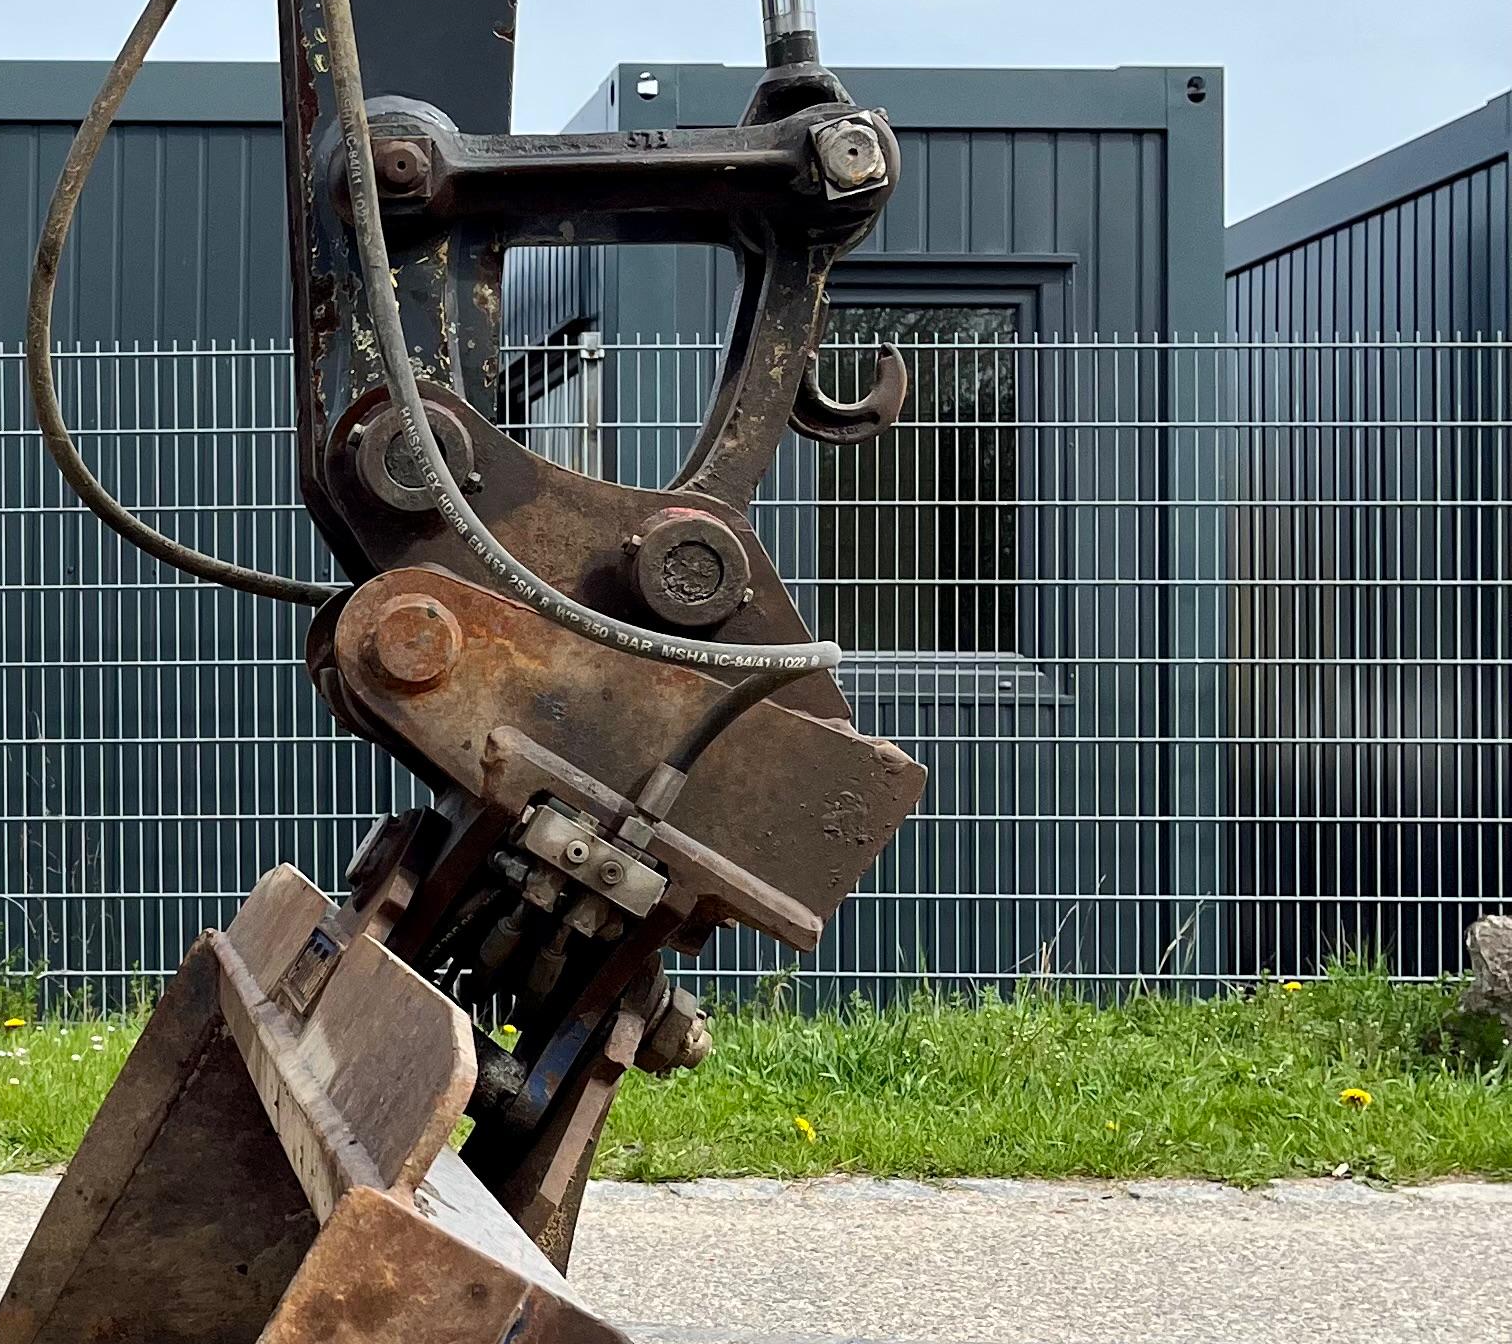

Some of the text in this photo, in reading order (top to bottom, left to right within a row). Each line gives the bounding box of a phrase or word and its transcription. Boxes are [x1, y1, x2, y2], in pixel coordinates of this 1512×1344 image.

[399, 406, 442, 492] HANSA-FLEX
[438, 493, 469, 535] HD208
[467, 534, 487, 556] EN
[484, 551, 506, 576] 853
[508, 574, 537, 601] 2SN
[582, 619, 609, 639] 350
[616, 632, 653, 653] BAR
[660, 644, 710, 665] MSHA
[714, 653, 771, 669] IC-84/41
